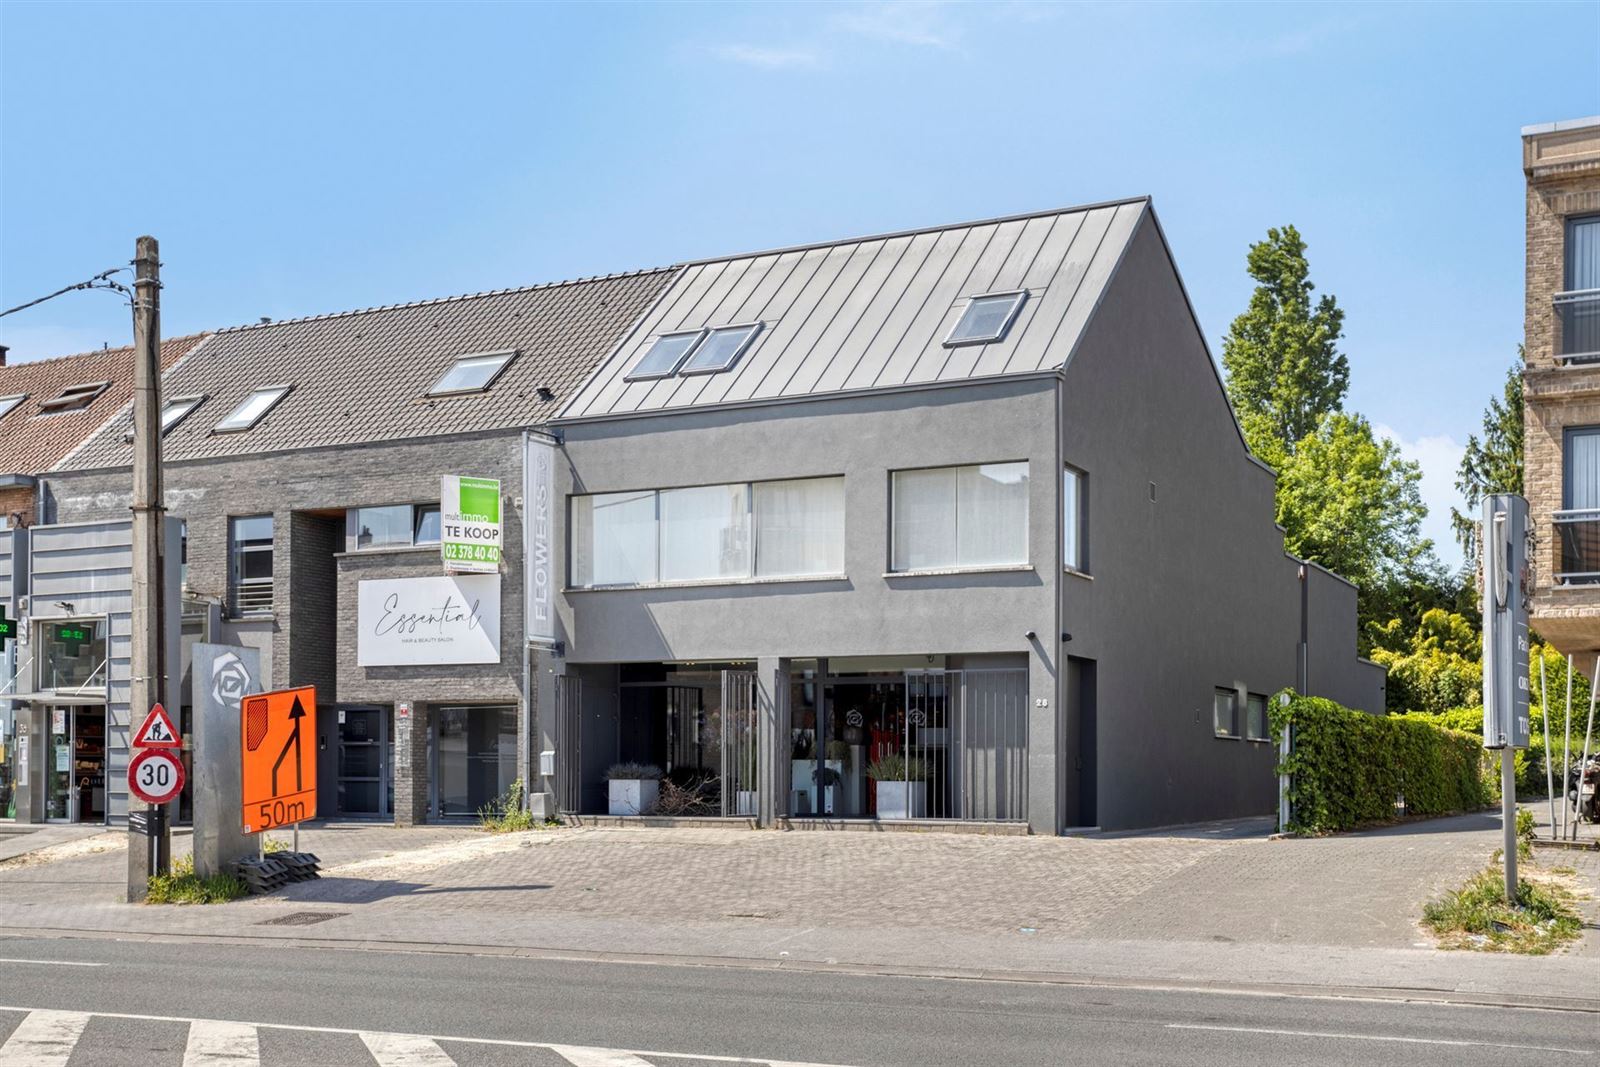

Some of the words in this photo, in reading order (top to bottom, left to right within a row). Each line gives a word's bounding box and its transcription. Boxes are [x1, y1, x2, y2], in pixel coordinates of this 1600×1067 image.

[445, 525, 460, 538] TE
[464, 526, 499, 540] KOOP
[445, 543, 457, 558] 02
[458, 544, 473, 559] 378
[474, 545, 486, 561] 40
[487, 546, 499, 561] 40
[535, 486, 548, 622] FLOWERS
[375, 592, 482, 637] Essential
[142, 764, 169, 786] 30
[260, 800, 305, 829] 50m
